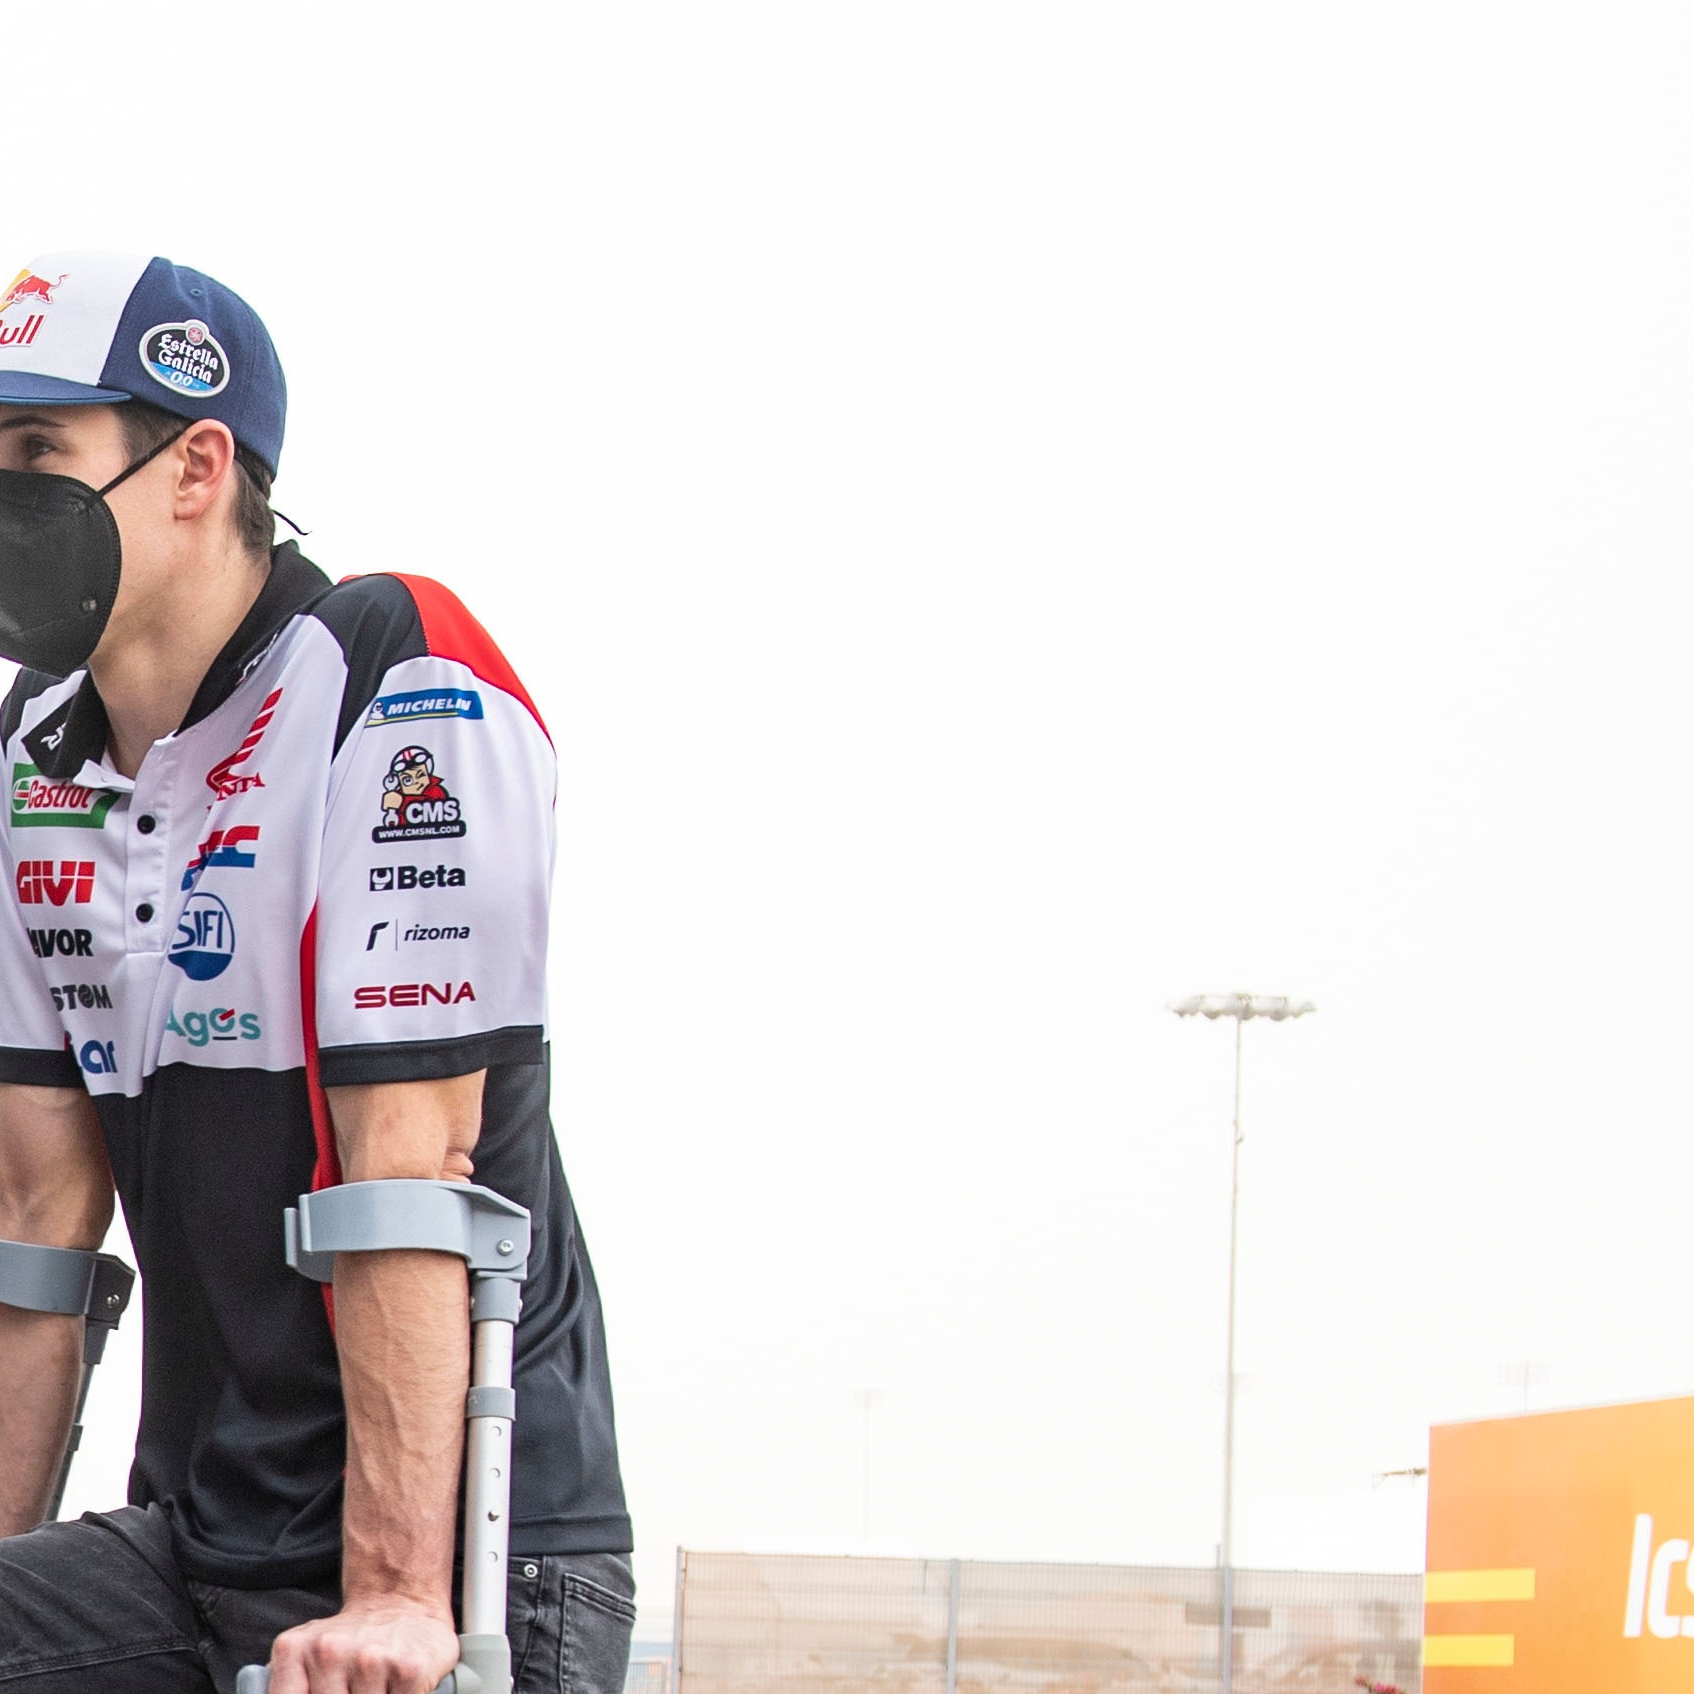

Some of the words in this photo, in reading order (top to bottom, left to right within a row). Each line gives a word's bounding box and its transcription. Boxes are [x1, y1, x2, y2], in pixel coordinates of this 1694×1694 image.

[158, 333, 218, 370] Estrella
[158, 349, 212, 383] Galicia
[387, 698, 472, 715] MICHELIN
[28, 779, 95, 809] Castrol
[406, 800, 459, 824] CMS
[378, 825, 460, 839] WWW.CMSNL.COM
[16, 861, 96, 906] GIVI
[397, 865, 466, 890] Beta
[26, 928, 94, 958] VOR
[172, 910, 223, 949] SIFI
[404, 924, 470, 942] rizoma
[354, 981, 476, 1009] SENA
[165, 1008, 261, 1047] Agos
